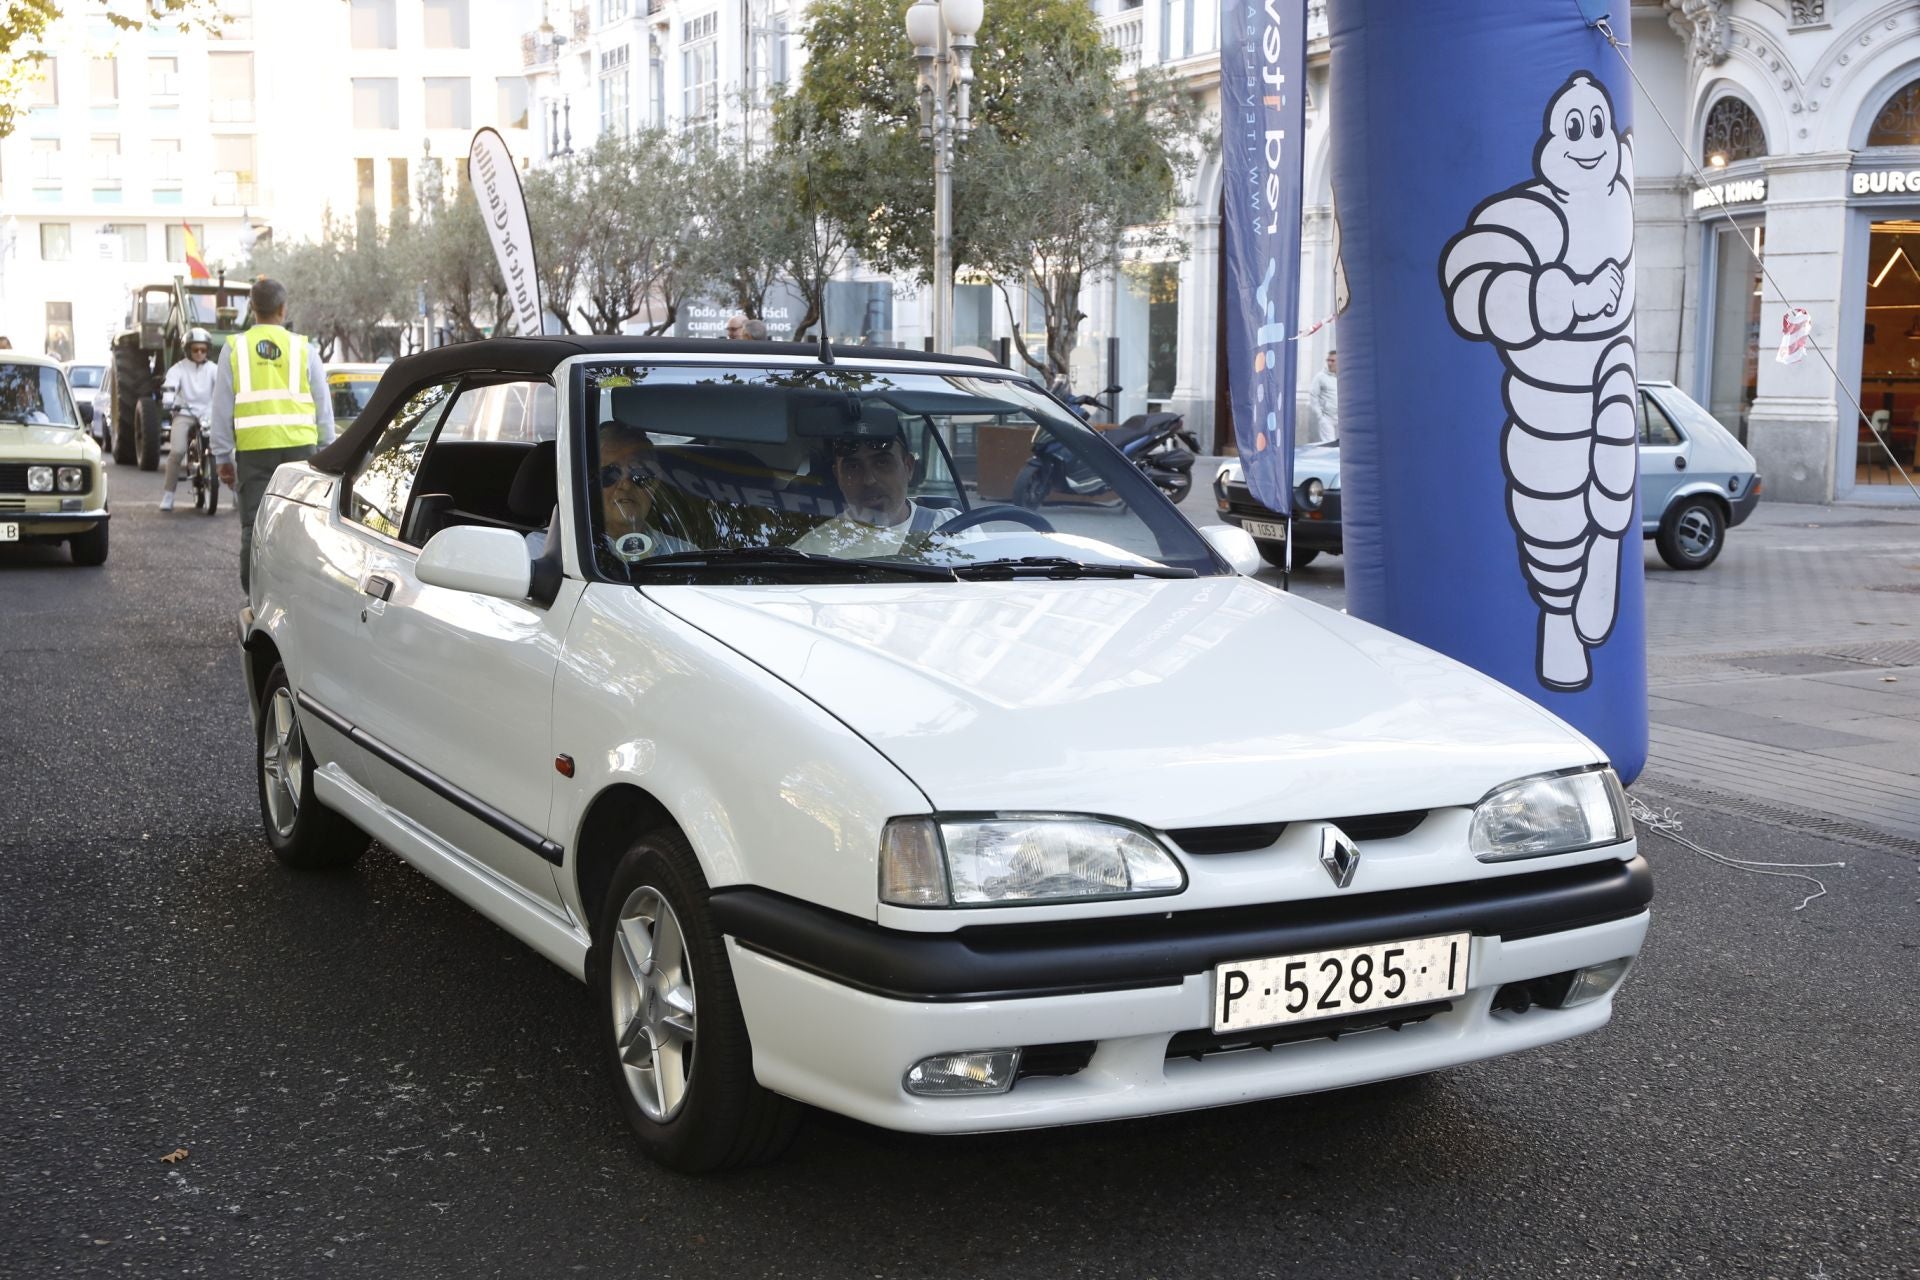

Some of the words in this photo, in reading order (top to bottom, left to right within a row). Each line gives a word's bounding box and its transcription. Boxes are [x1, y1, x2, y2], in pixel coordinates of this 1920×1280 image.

[1725, 179, 1765, 203] KING
[1852, 171, 1920, 195] BURG
[687, 306, 717, 318] Todo
